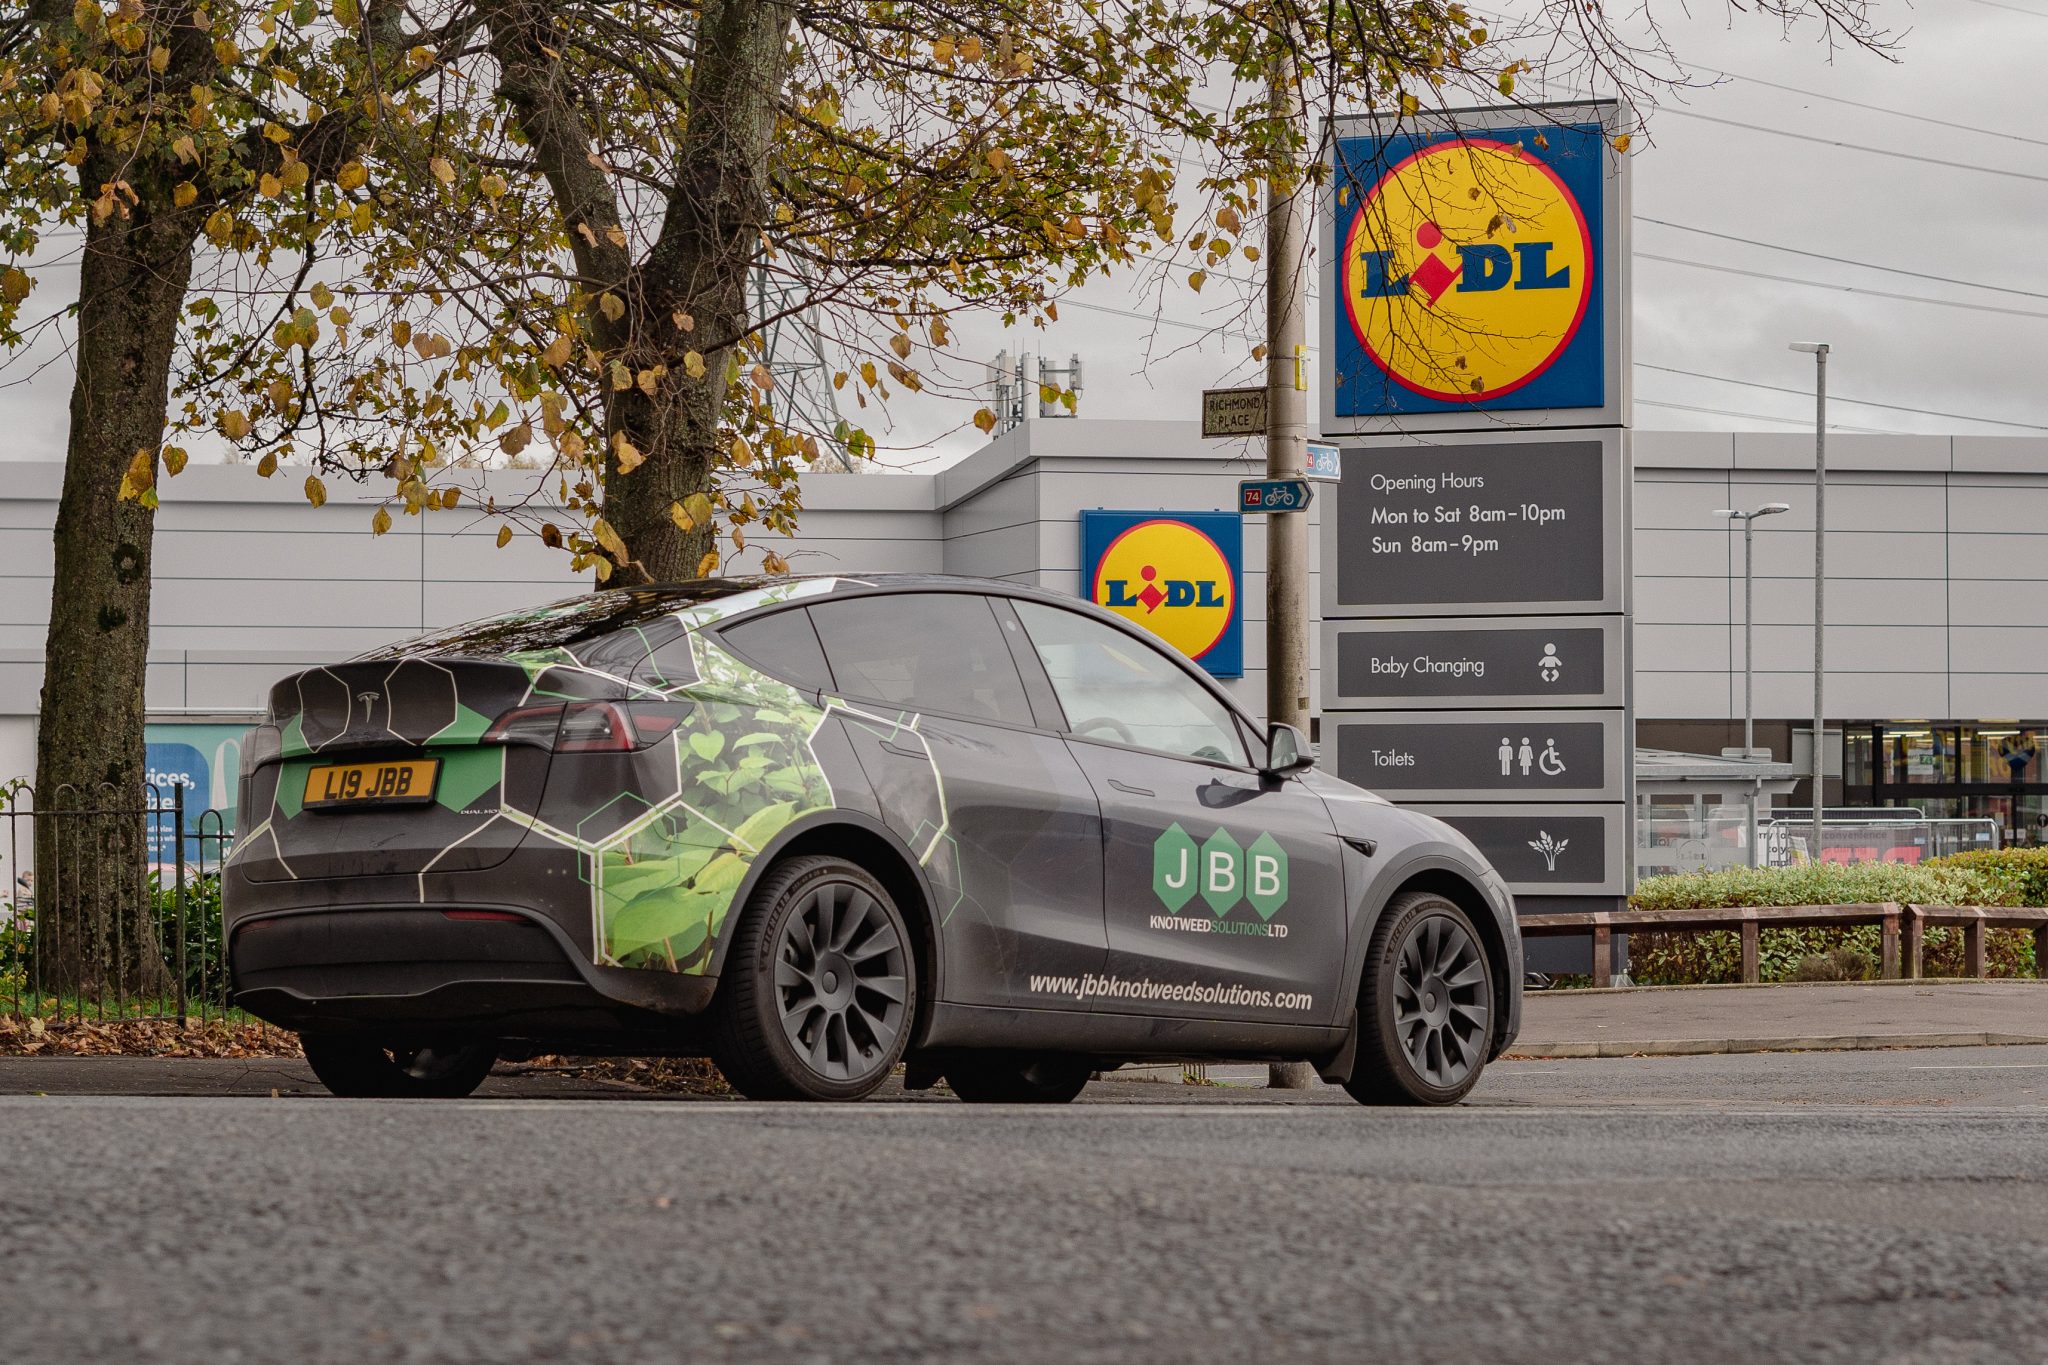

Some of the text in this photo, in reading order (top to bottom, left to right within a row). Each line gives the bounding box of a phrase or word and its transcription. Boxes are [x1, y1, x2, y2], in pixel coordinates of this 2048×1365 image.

[1360, 221, 1571, 308] LIDL
[1209, 397, 1261, 411] RICHMOND
[1218, 414, 1250, 427] PLACE
[1370, 472, 1485, 495] Opening Hours
[1246, 491, 1260, 502] 74
[1370, 507, 1408, 525] Mon
[1413, 508, 1430, 523] to
[1434, 505, 1462, 523] Sat
[1371, 537, 1402, 554] Sun
[1105, 565, 1224, 615] LIDL
[1371, 655, 1485, 678] Baby Changing
[1372, 749, 1415, 767] Toilets
[323, 766, 413, 800] L19 JBB
[762, 892, 791, 955] MICHELIN
[1390, 909, 1417, 950] MICHELIN
[1030, 974, 1312, 1010] www.jbbknotweedsolutions.com
